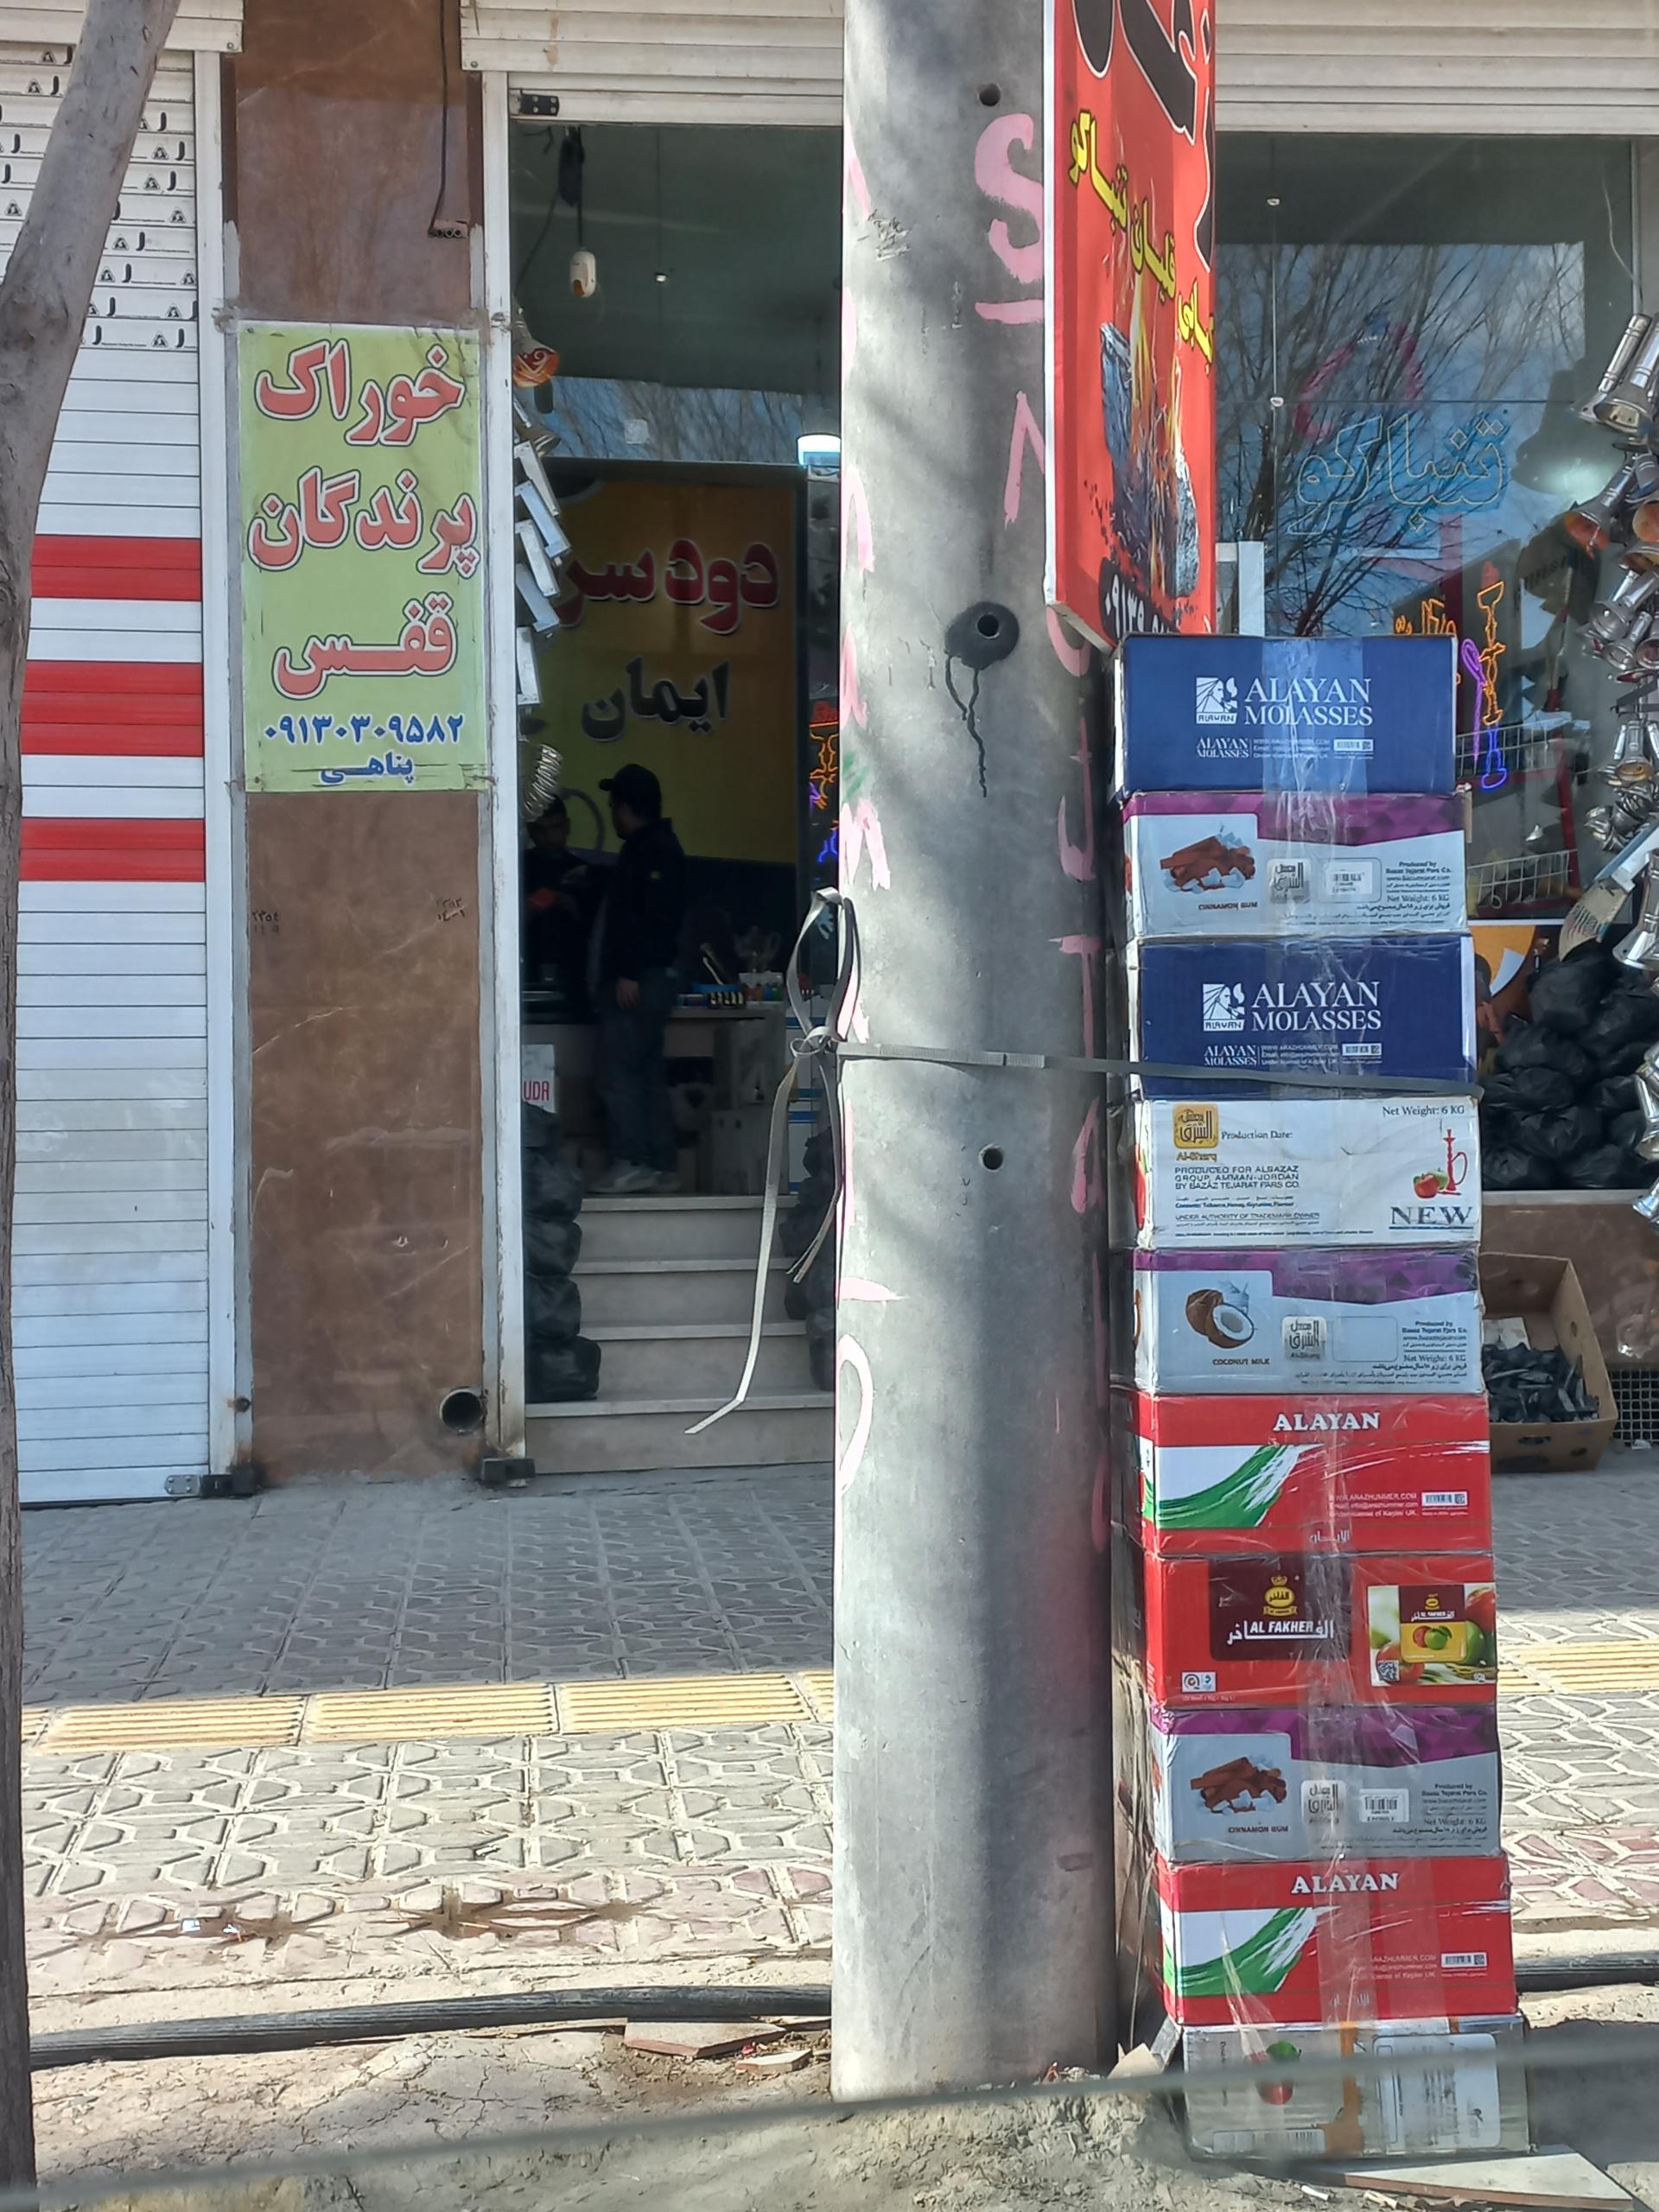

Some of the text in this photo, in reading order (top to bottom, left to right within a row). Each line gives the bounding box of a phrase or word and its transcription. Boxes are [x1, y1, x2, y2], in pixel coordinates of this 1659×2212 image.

[1068, 109, 1128, 236] تنباکو
[1130, 198, 1176, 306] قلیان
[255, 339, 465, 446] خوراک
[1287, 412, 1504, 535] تنباکو
[248, 466, 480, 578] پرندگان
[271, 592, 459, 699] قفس
[581, 656, 733, 742] ایمان
[1244, 677, 1371, 702] ALAYAN
[1244, 705, 1373, 726] MOLASSES
[264, 713, 464, 745] ۰۹۱۳۰۳۰۹۵۸۲
[1196, 737, 1248, 749] ALAYAN
[1197, 749, 1249, 758] MOLASSES
[320, 752, 414, 785] پناهی
[1251, 982, 1380, 1007] ALAYAN
[1251, 1010, 1382, 1031] MOLASSES
[1204, 1045, 1256, 1056] ALAYAN
[1204, 1057, 1257, 1065] MOLASSES
[1382, 1106, 1400, 1116] Net
[1403, 1105, 1440, 1116] Weight:
[1451, 1105, 1465, 1114] KG
[1221, 1130, 1268, 1140] Production
[1390, 1206, 1472, 1224] NEW
[1273, 1412, 1381, 1431] ALAYAN
[1227, 1619, 1334, 1645] الفاخر
[1249, 1621, 1313, 1633] AL FAKHER
[1291, 1873, 1399, 1894] ALAYAN
